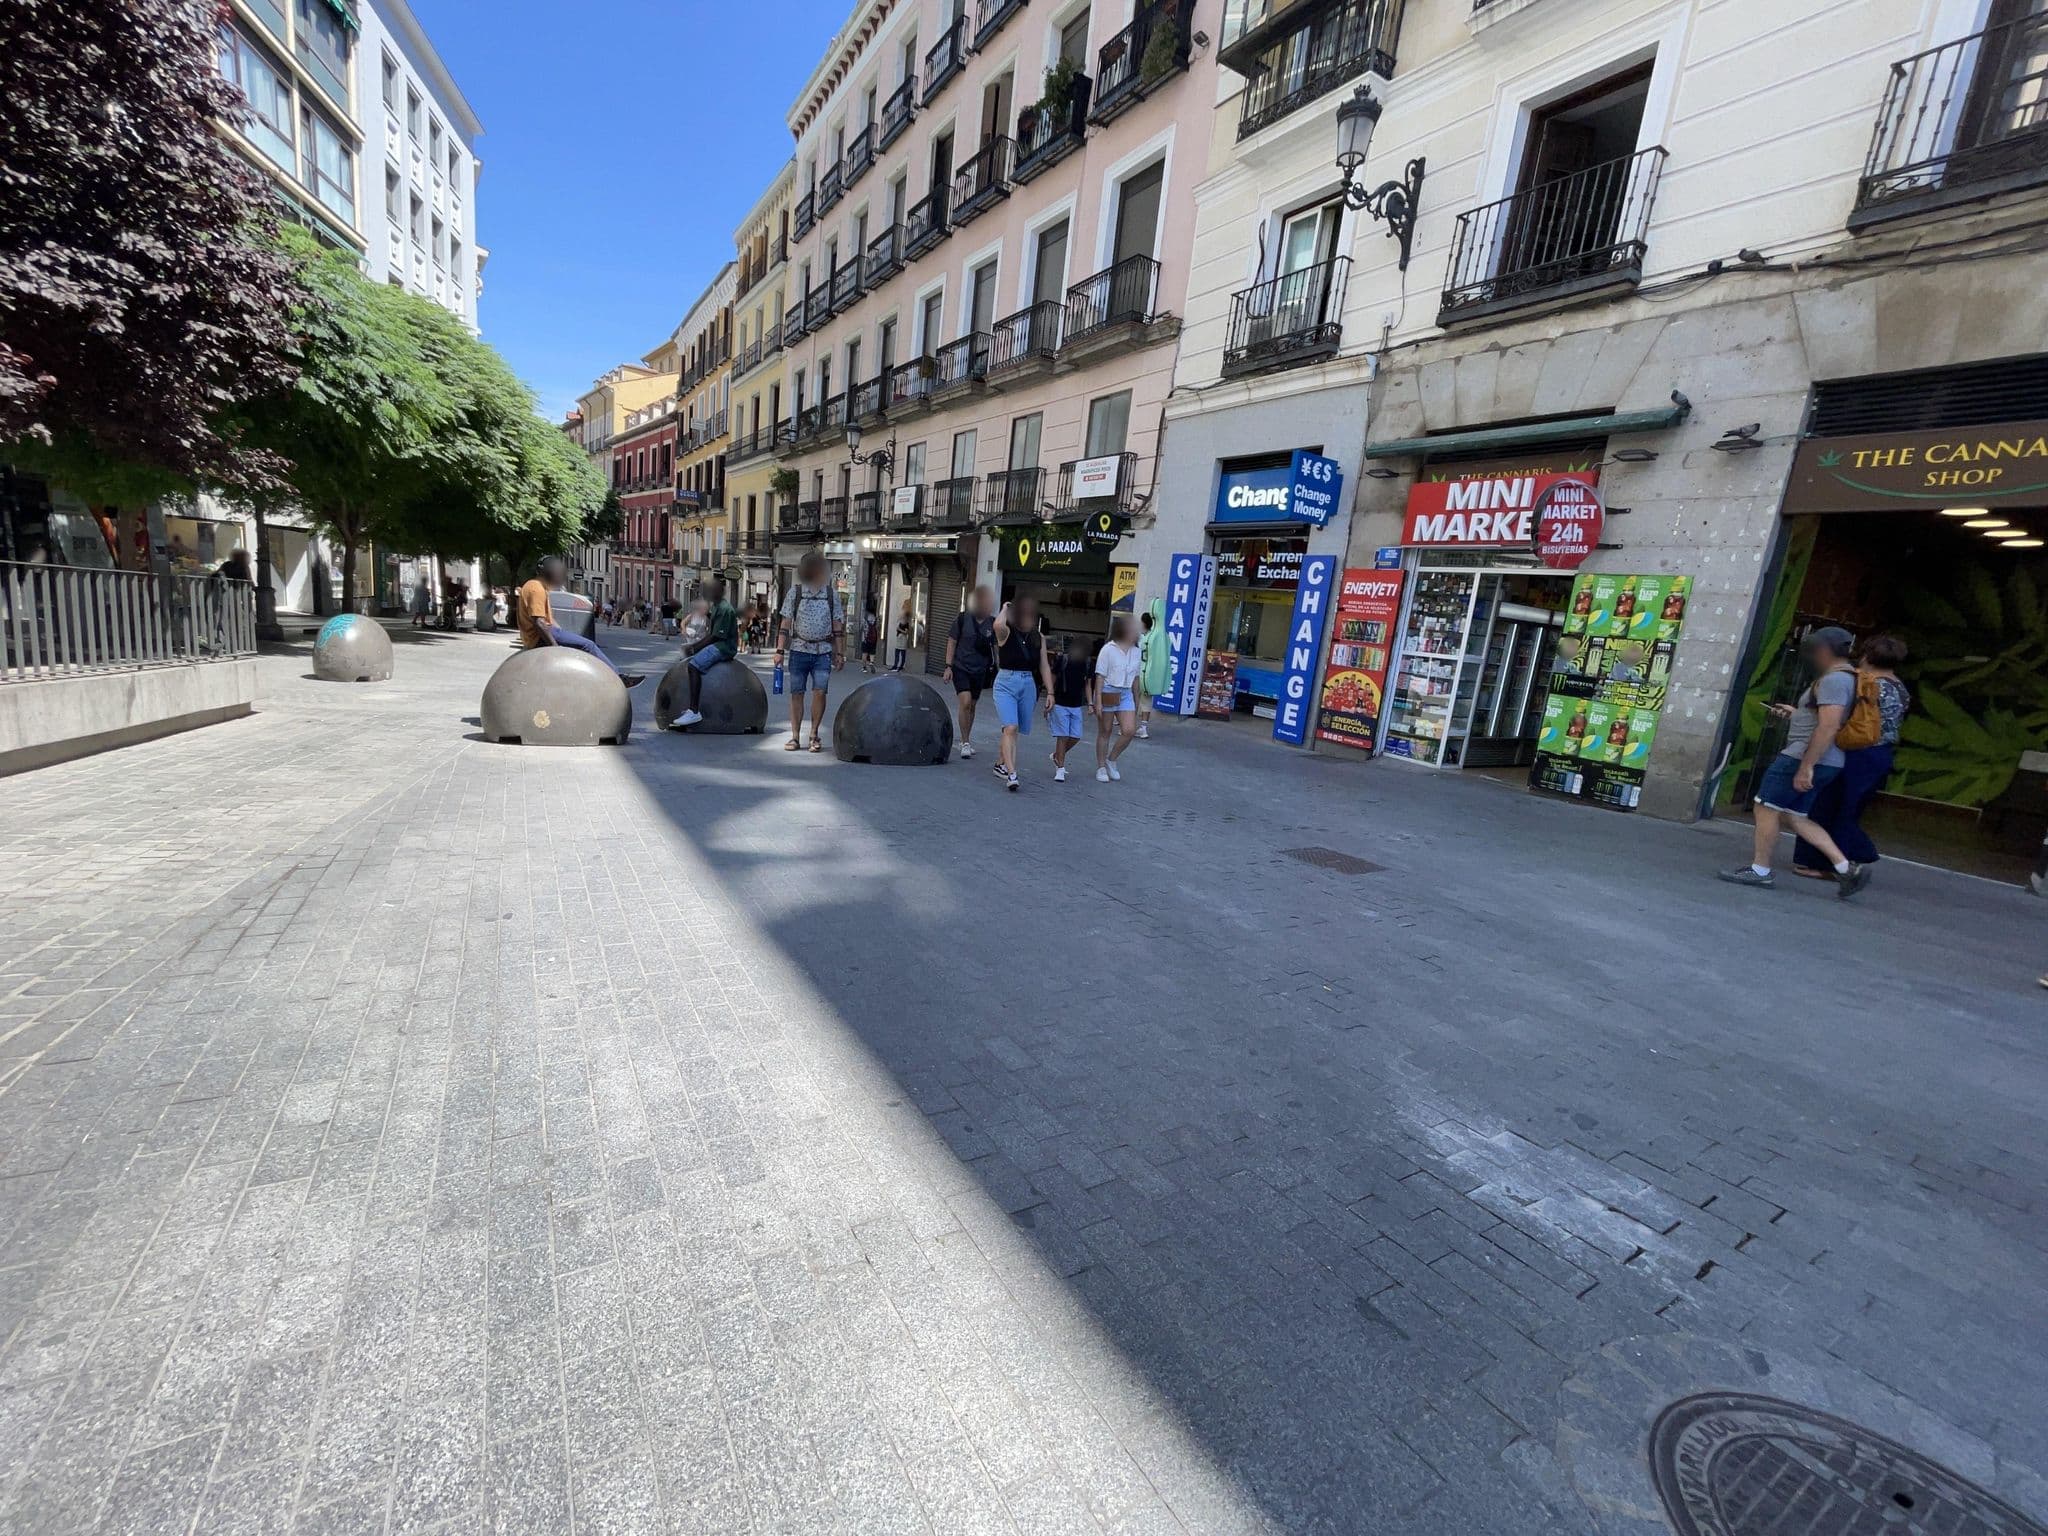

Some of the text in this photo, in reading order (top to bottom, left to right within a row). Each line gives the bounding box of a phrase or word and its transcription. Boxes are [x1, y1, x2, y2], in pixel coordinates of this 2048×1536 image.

[1852, 437, 2048, 468] THE CANNA
[1924, 468, 2003, 487] SHOP
[1228, 485, 1290, 511] Chang
[1294, 484, 1331, 506] Change
[1445, 477, 1536, 511] MINI
[1554, 488, 1584, 503] MINI
[1293, 500, 1327, 522] Money
[1543, 504, 1597, 519] MARKET
[1087, 530, 1119, 541] LA PARADA
[1412, 510, 1533, 542] MARKE
[1550, 522, 1583, 543] 24h
[1036, 541, 1083, 553] LA PARADA
[1542, 545, 1589, 555] BISUTERÍAS
[1119, 569, 1136, 581] ATM
[1257, 565, 1301, 580] Excha
[1343, 581, 1398, 599] ENERYETI
[1186, 561, 1213, 709] CHANGE MONEY
[1282, 561, 1325, 727] CHANGE
[1331, 721, 1371, 736] SELECCIÓN
